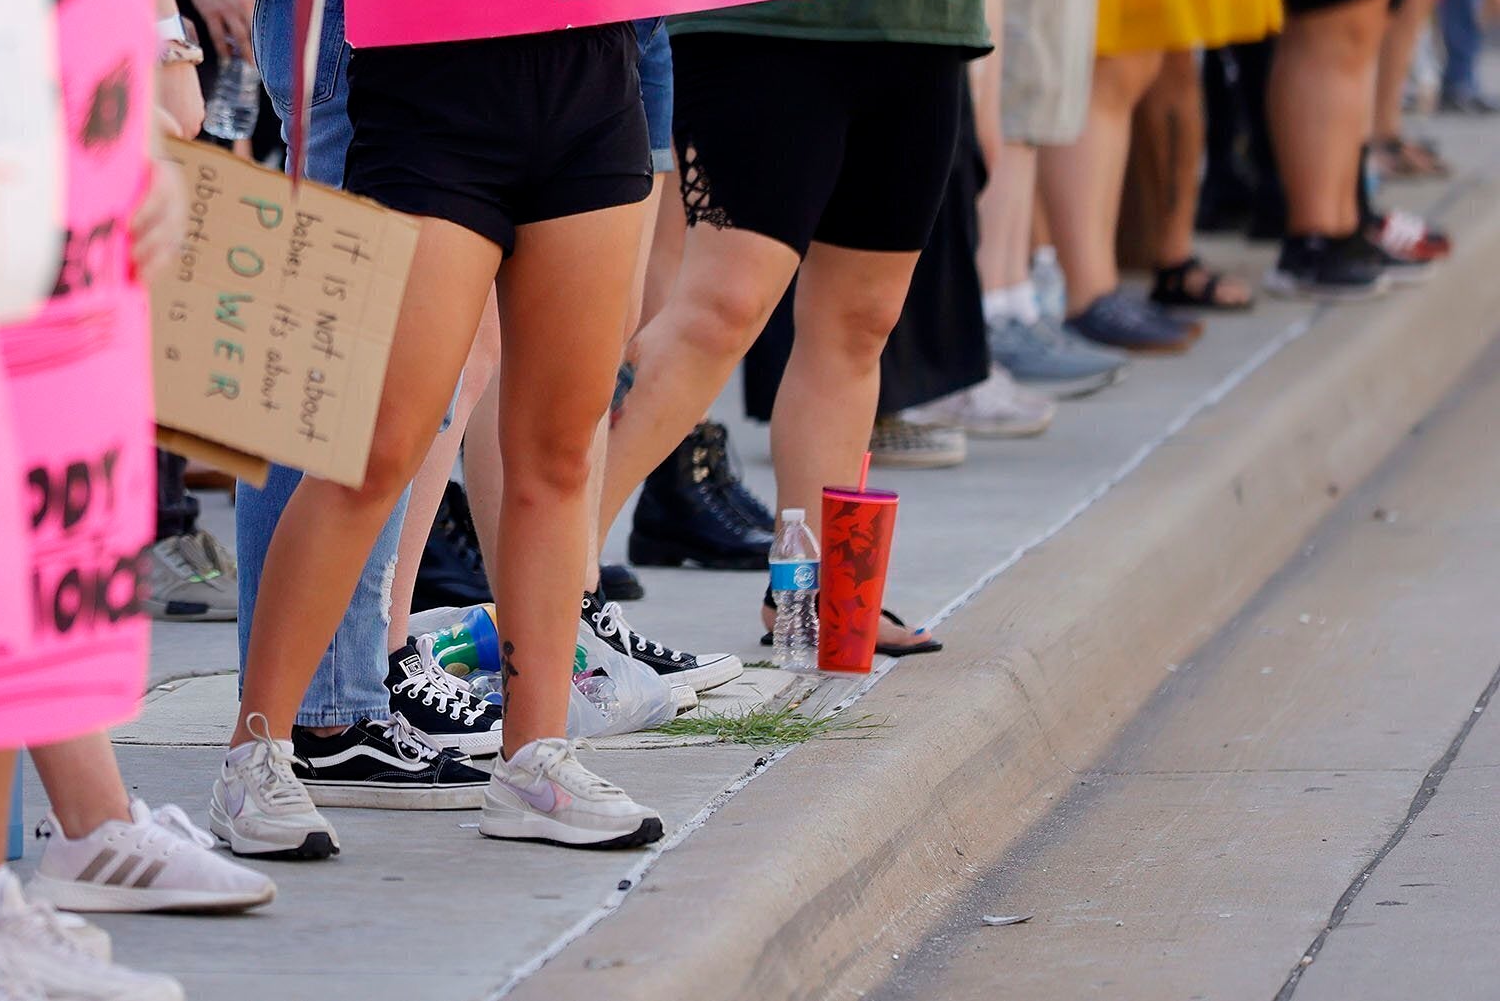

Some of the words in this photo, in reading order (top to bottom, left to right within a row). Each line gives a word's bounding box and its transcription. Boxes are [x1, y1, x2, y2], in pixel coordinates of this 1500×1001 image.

[176, 165, 223, 283] abortion
[205, 195, 284, 400] POWER
[164, 345, 181, 363] a
[260, 349, 291, 413] about
[298, 367, 336, 443] about
